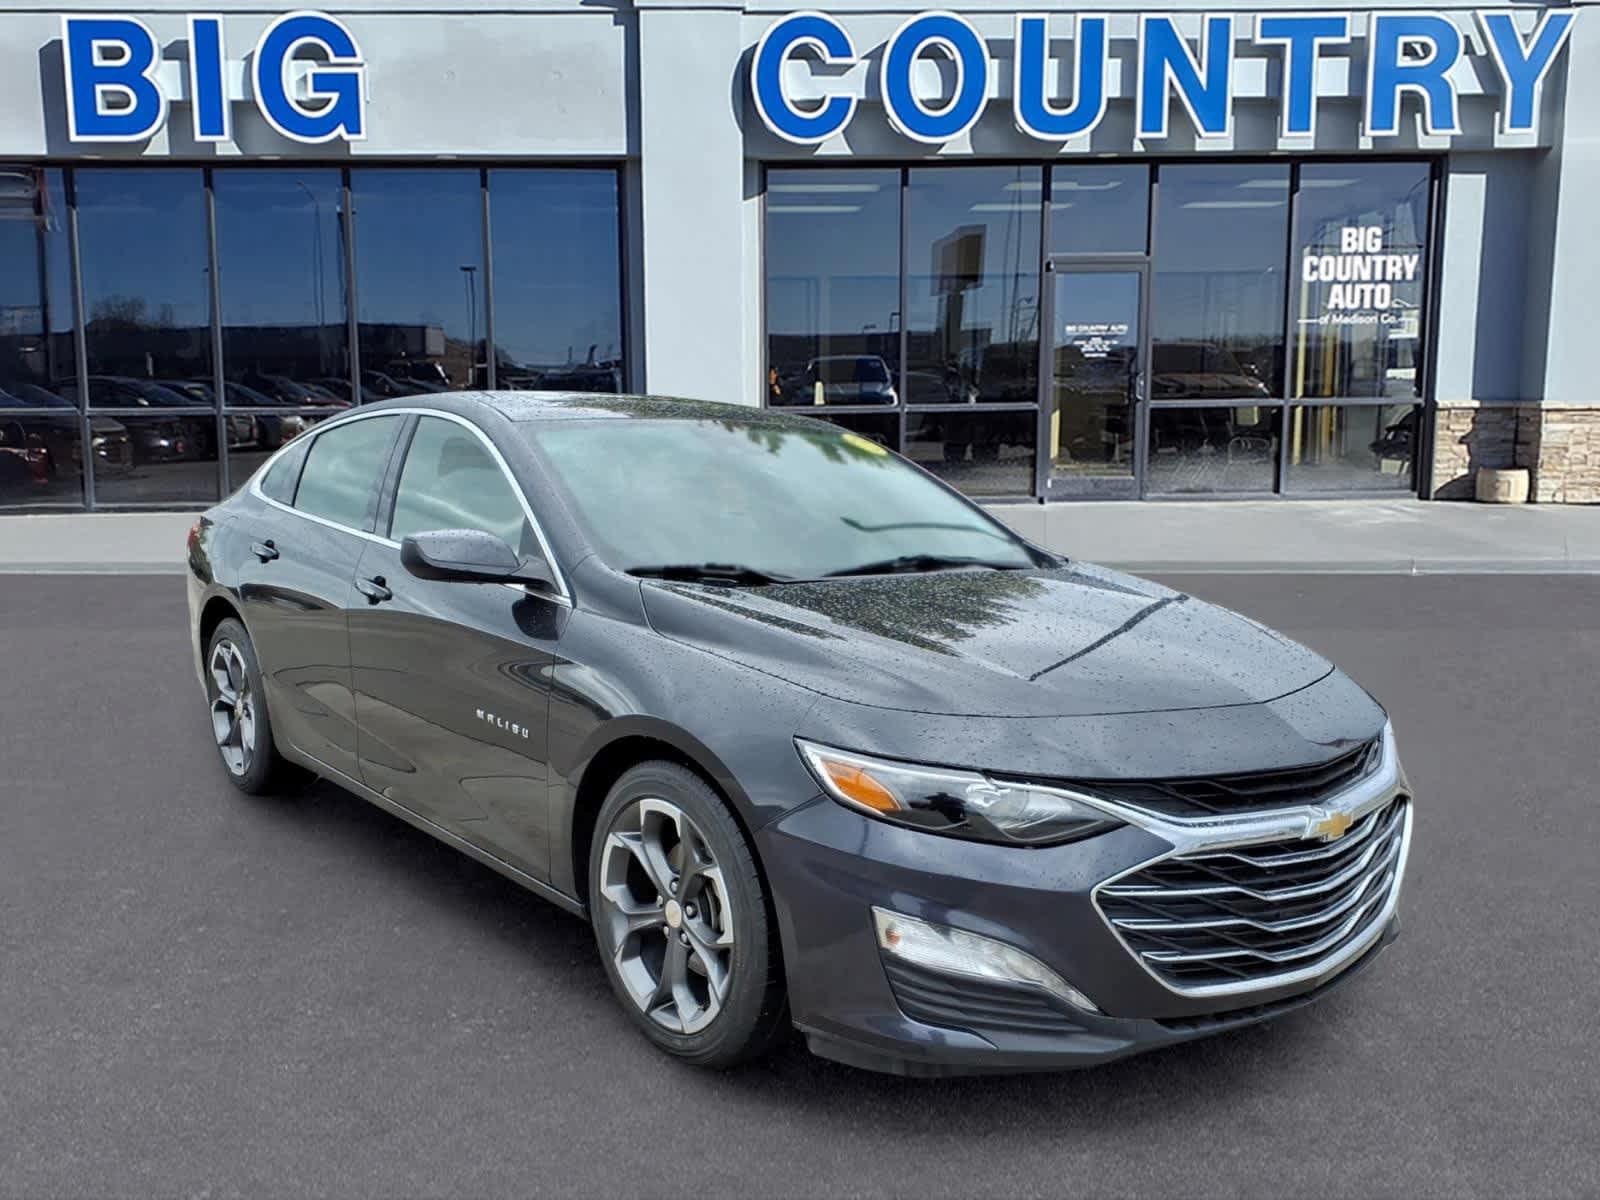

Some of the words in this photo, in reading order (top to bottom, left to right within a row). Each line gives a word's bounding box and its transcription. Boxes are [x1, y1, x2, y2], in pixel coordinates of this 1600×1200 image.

[61, 10, 368, 144] BIG
[751, 10, 1576, 144] COUNTRY
[1341, 226, 1383, 253] BIG
[1303, 255, 1418, 281] COUNTRY
[1327, 283, 1391, 309] AUTO
[1319, 313, 1331, 325] of
[1332, 313, 1378, 325] Madison
[476, 708, 529, 738] MALIBU
